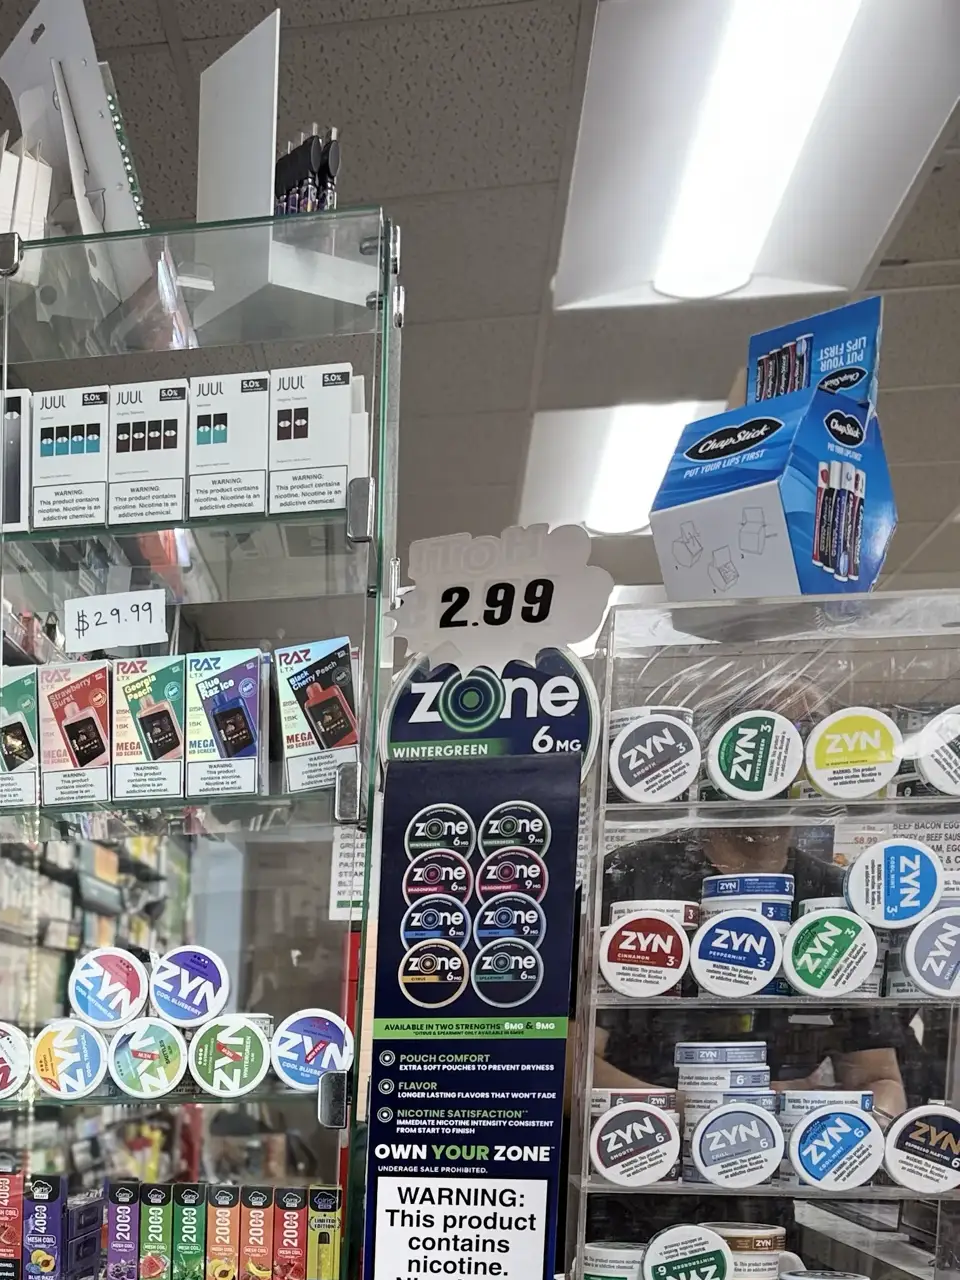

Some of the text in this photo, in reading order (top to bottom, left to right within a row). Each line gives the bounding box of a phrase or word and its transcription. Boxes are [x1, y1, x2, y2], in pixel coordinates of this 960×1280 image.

[820, 336, 866, 360] LIPS FIRST
[820, 350, 864, 372] PUT YOUR
[40, 393, 101, 410] JUUL 5.0%
[116, 388, 179, 405] JUUL 5.0%
[699, 425, 770, 454] ChapStick
[684, 450, 764, 479] PUT YOUR LIPS FIRST
[439, 578, 555, 629] 2.99
[75, 601, 153, 638] $29.99
[408, 666, 580, 733] zone
[116, 741, 141, 750] MEGA
[393, 744, 488, 758] WINTERGREEN
[826, 730, 881, 754] ZYN
[730, 727, 760, 782] ZYN
[415, 818, 468, 840] zone
[488, 815, 543, 839] zone
[486, 861, 541, 882] zone
[900, 854, 920, 908] ZYN
[617, 953, 650, 961] CINNAMON
[709, 950, 746, 961] PEPPERMINT
[400, 1054, 490, 1063] POUCH COMFORT
[399, 1082, 437, 1090] FLAVOR
[397, 1110, 445, 1118] NICOTINE
[601, 1117, 665, 1154] ZYN 6
[375, 1144, 550, 1161] OWN YOUR ZONE
[441, 1166, 488, 1174] PROHIBITED.
[398, 1186, 525, 1207] WARNING:
[116, 1206, 131, 1241] 2000
[181, 1207, 197, 1243] 2000
[385, 1209, 536, 1233] This product
[408, 1234, 510, 1253] contains
[408, 1256, 508, 1276] nicotine.
